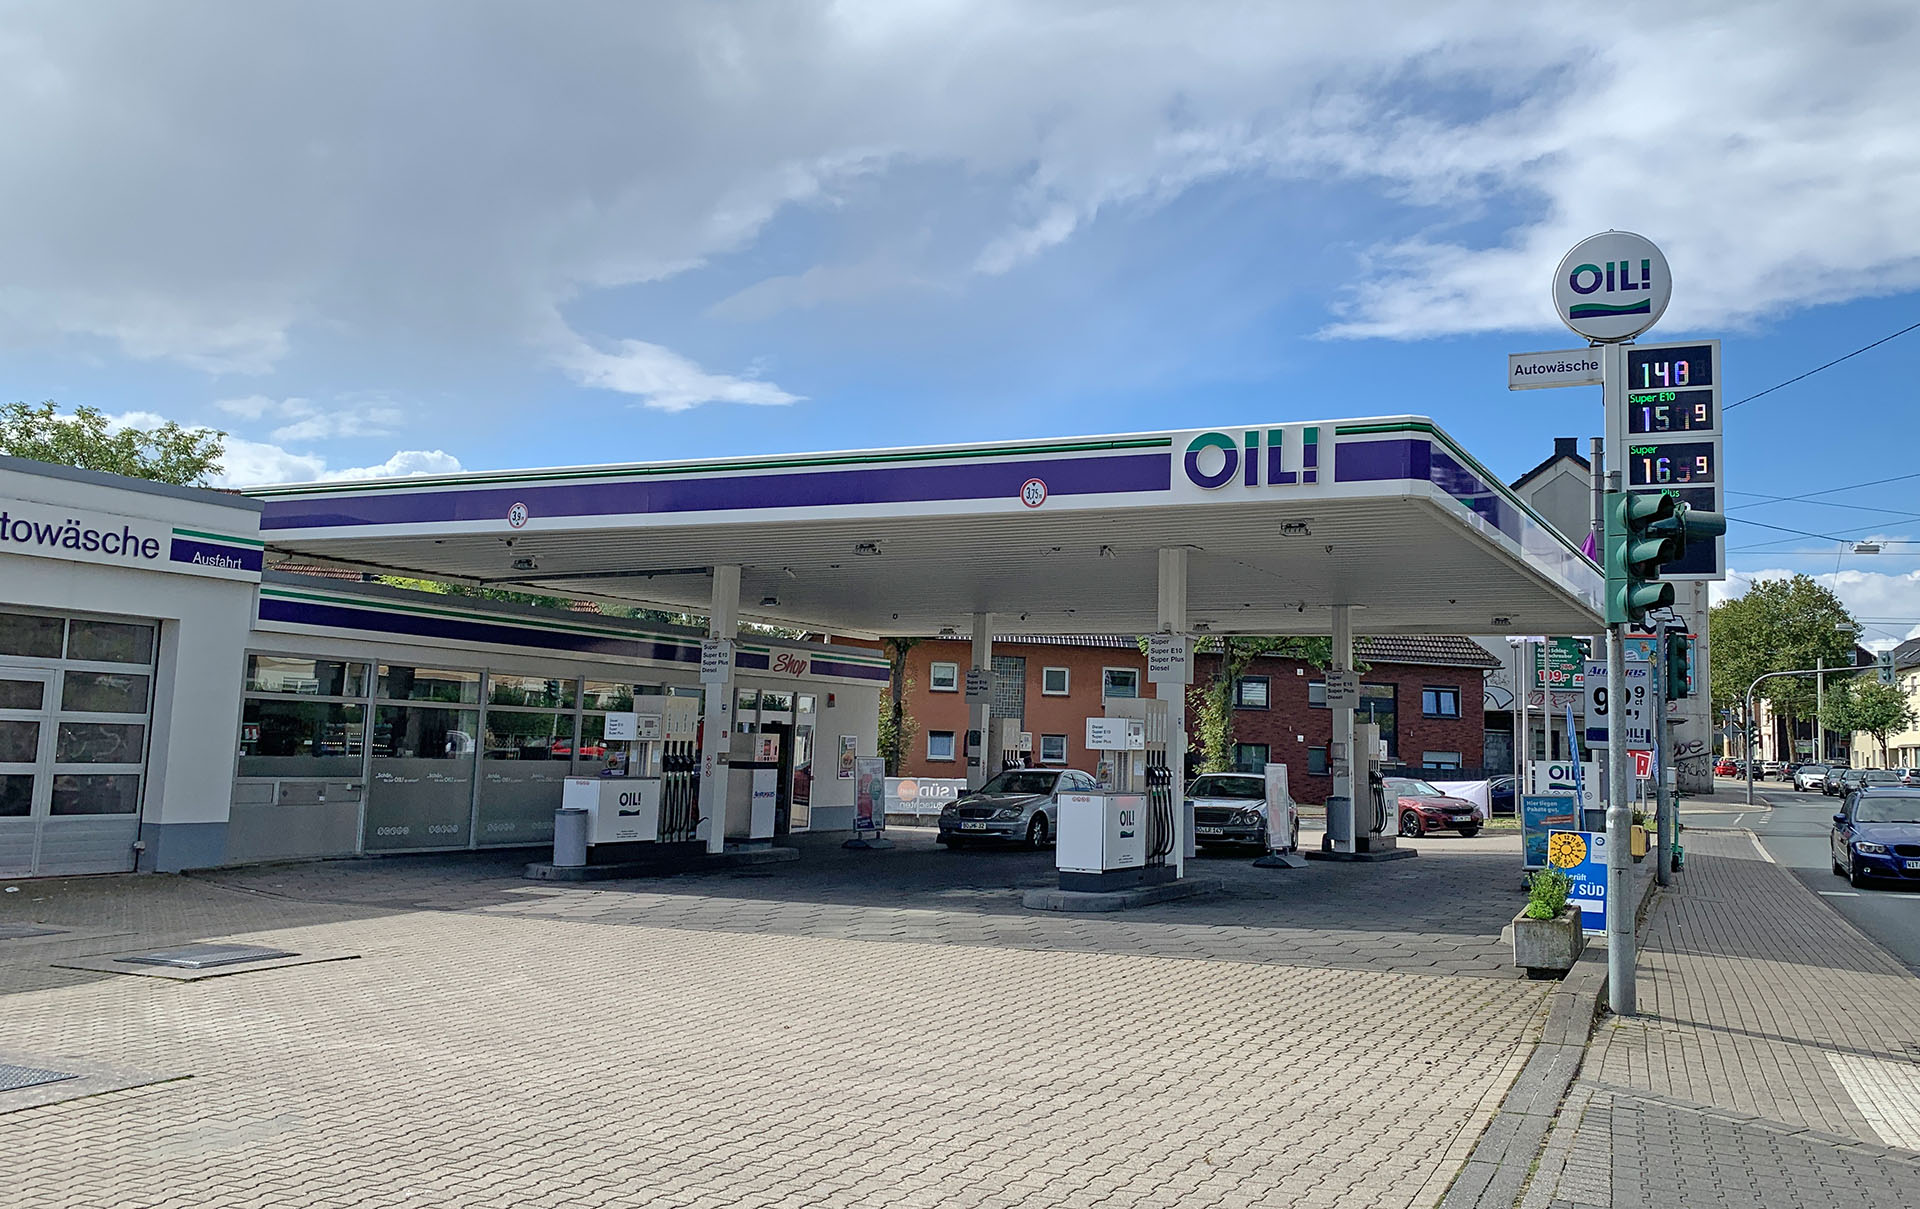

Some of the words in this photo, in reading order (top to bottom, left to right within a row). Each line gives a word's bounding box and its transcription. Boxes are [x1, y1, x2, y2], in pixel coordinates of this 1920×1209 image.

[1569, 259, 1651, 295] OIL!
[1514, 360, 1599, 376] Autowäsche
[1630, 394, 1657, 404] Super
[1660, 392, 1676, 402] E10
[1184, 427, 1319, 490] OIL!
[1630, 446, 1658, 456] Super
[192, 552, 242, 570] Ausfahrt
[773, 653, 807, 678] Shop
[619, 792, 641, 807] OIL!
[1120, 810, 1135, 827] OIL!
[1579, 882, 1605, 896] SÜD
